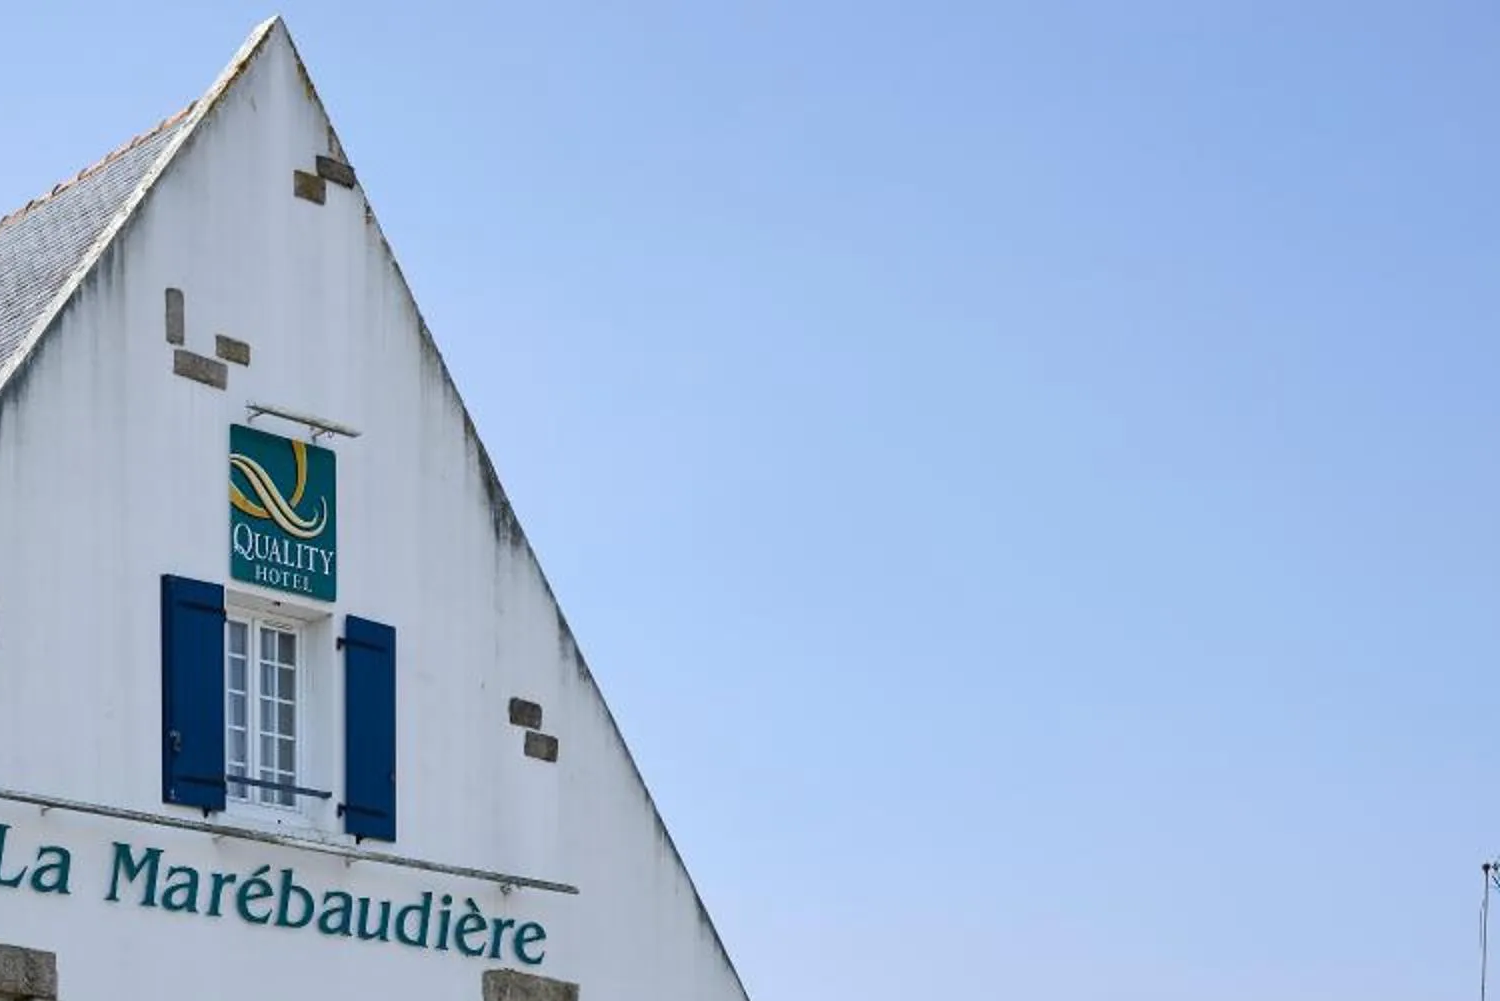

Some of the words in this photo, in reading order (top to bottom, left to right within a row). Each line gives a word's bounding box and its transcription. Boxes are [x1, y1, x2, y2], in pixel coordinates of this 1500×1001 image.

[233, 523, 334, 575] QUALITY
[255, 564, 313, 593] HOTEL
[104, 841, 547, 966] Marébaudière
